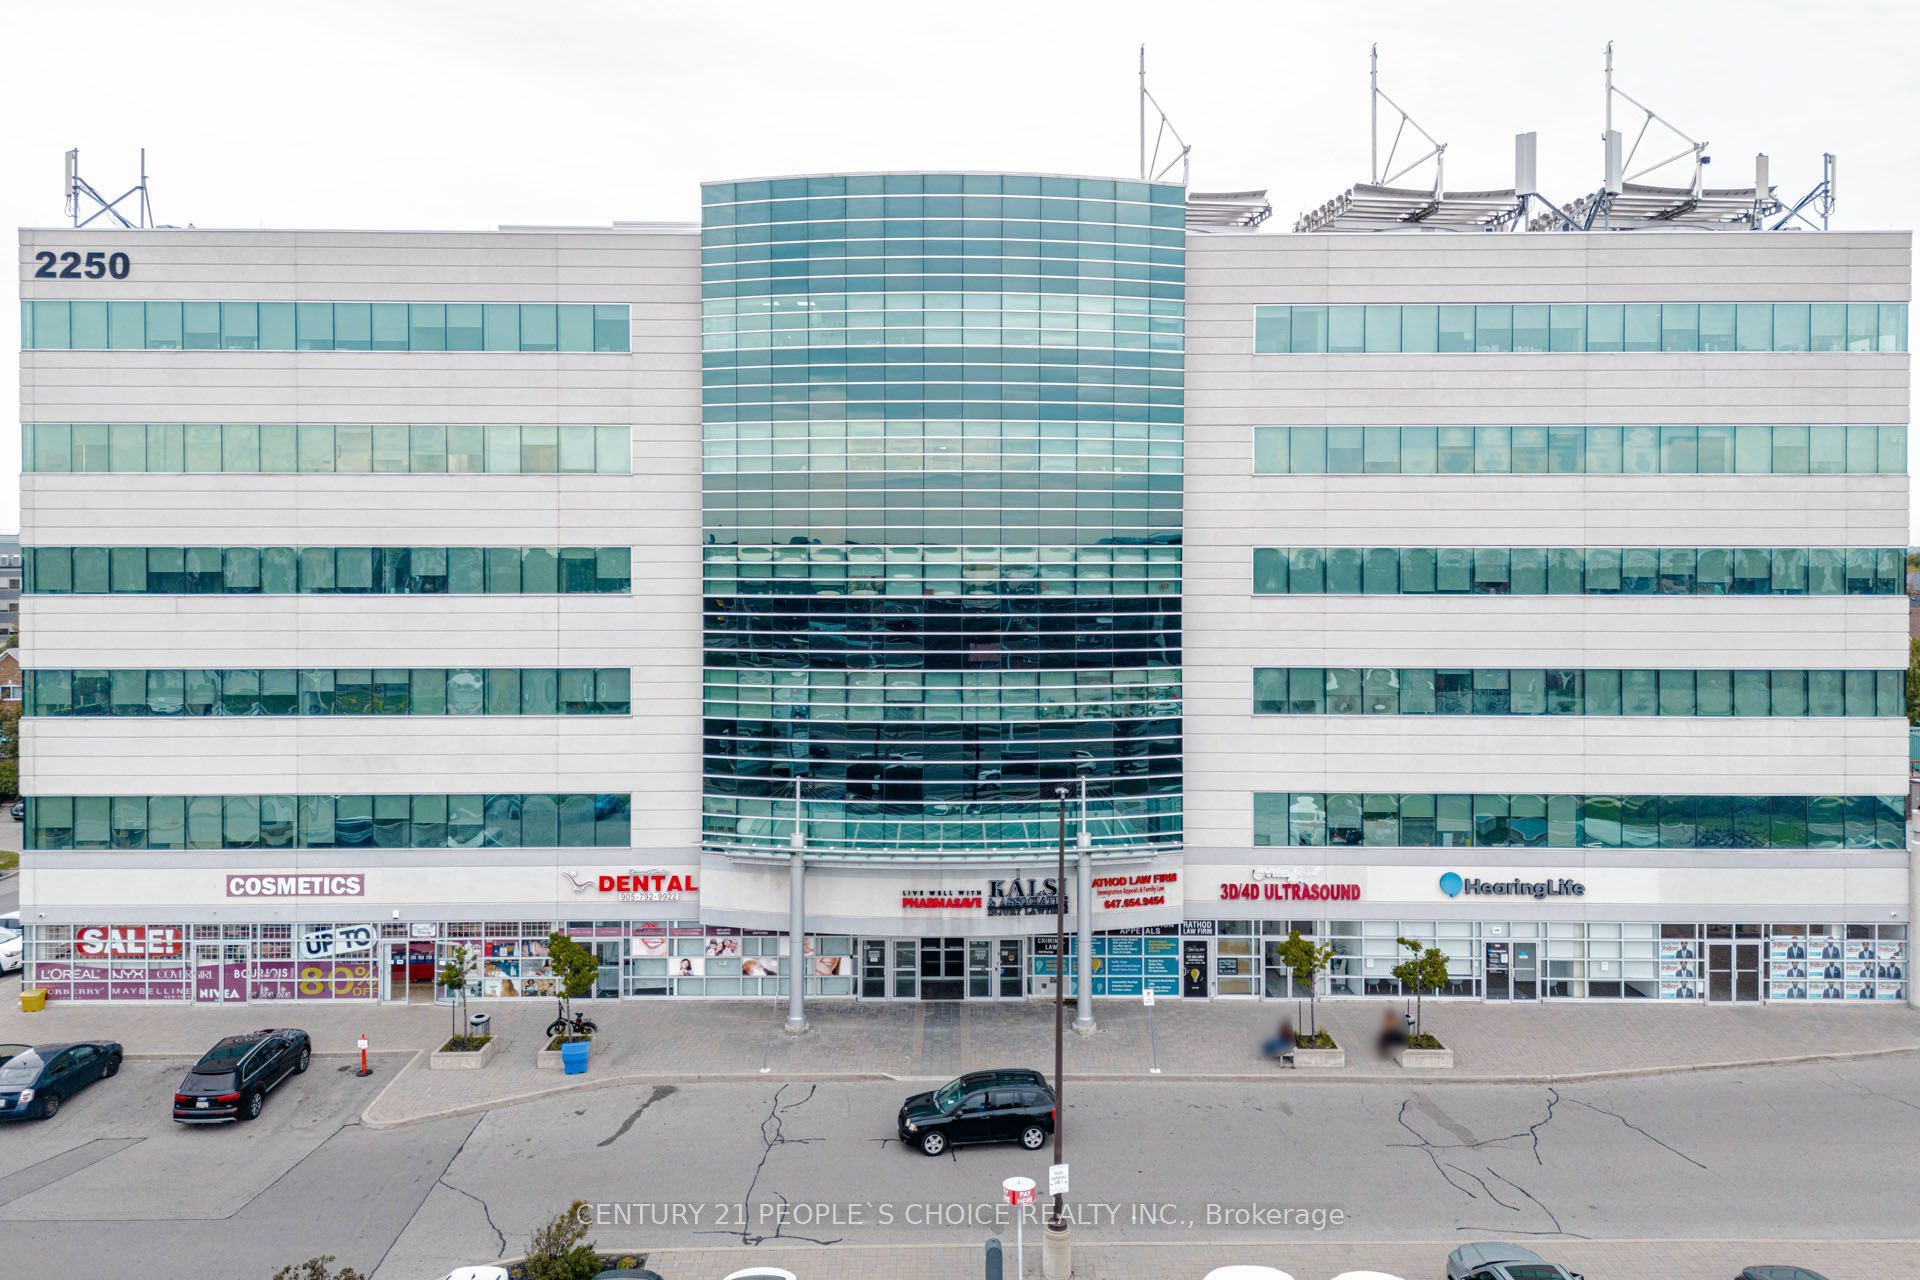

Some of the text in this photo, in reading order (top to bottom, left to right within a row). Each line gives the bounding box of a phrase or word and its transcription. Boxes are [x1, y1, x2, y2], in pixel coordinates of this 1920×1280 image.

[34, 251, 130, 279] 2250
[229, 876, 361, 895] COSMETICS
[598, 875, 698, 892] DENTAL
[1092, 873, 1177, 887] ATHOD LAW FIRM
[1220, 882, 1361, 900] 3D/4D ULTRASOUND
[1464, 878, 1585, 899] HearingLife
[902, 897, 982, 909] PHARMASAVE
[1183, 921, 1212, 929] RATHOD
[82, 928, 174, 954] SALE!
[305, 927, 371, 955] UP TO
[112, 970, 144, 979] NYX
[156, 969, 212, 979] COVRIRL
[300, 966, 379, 995] 80%
[199, 988, 240, 999] NIVEA
[352, 988, 378, 996] OFF
[1017, 1196, 1033, 1205] HERE
[1019, 1190, 1031, 1198] PAY
